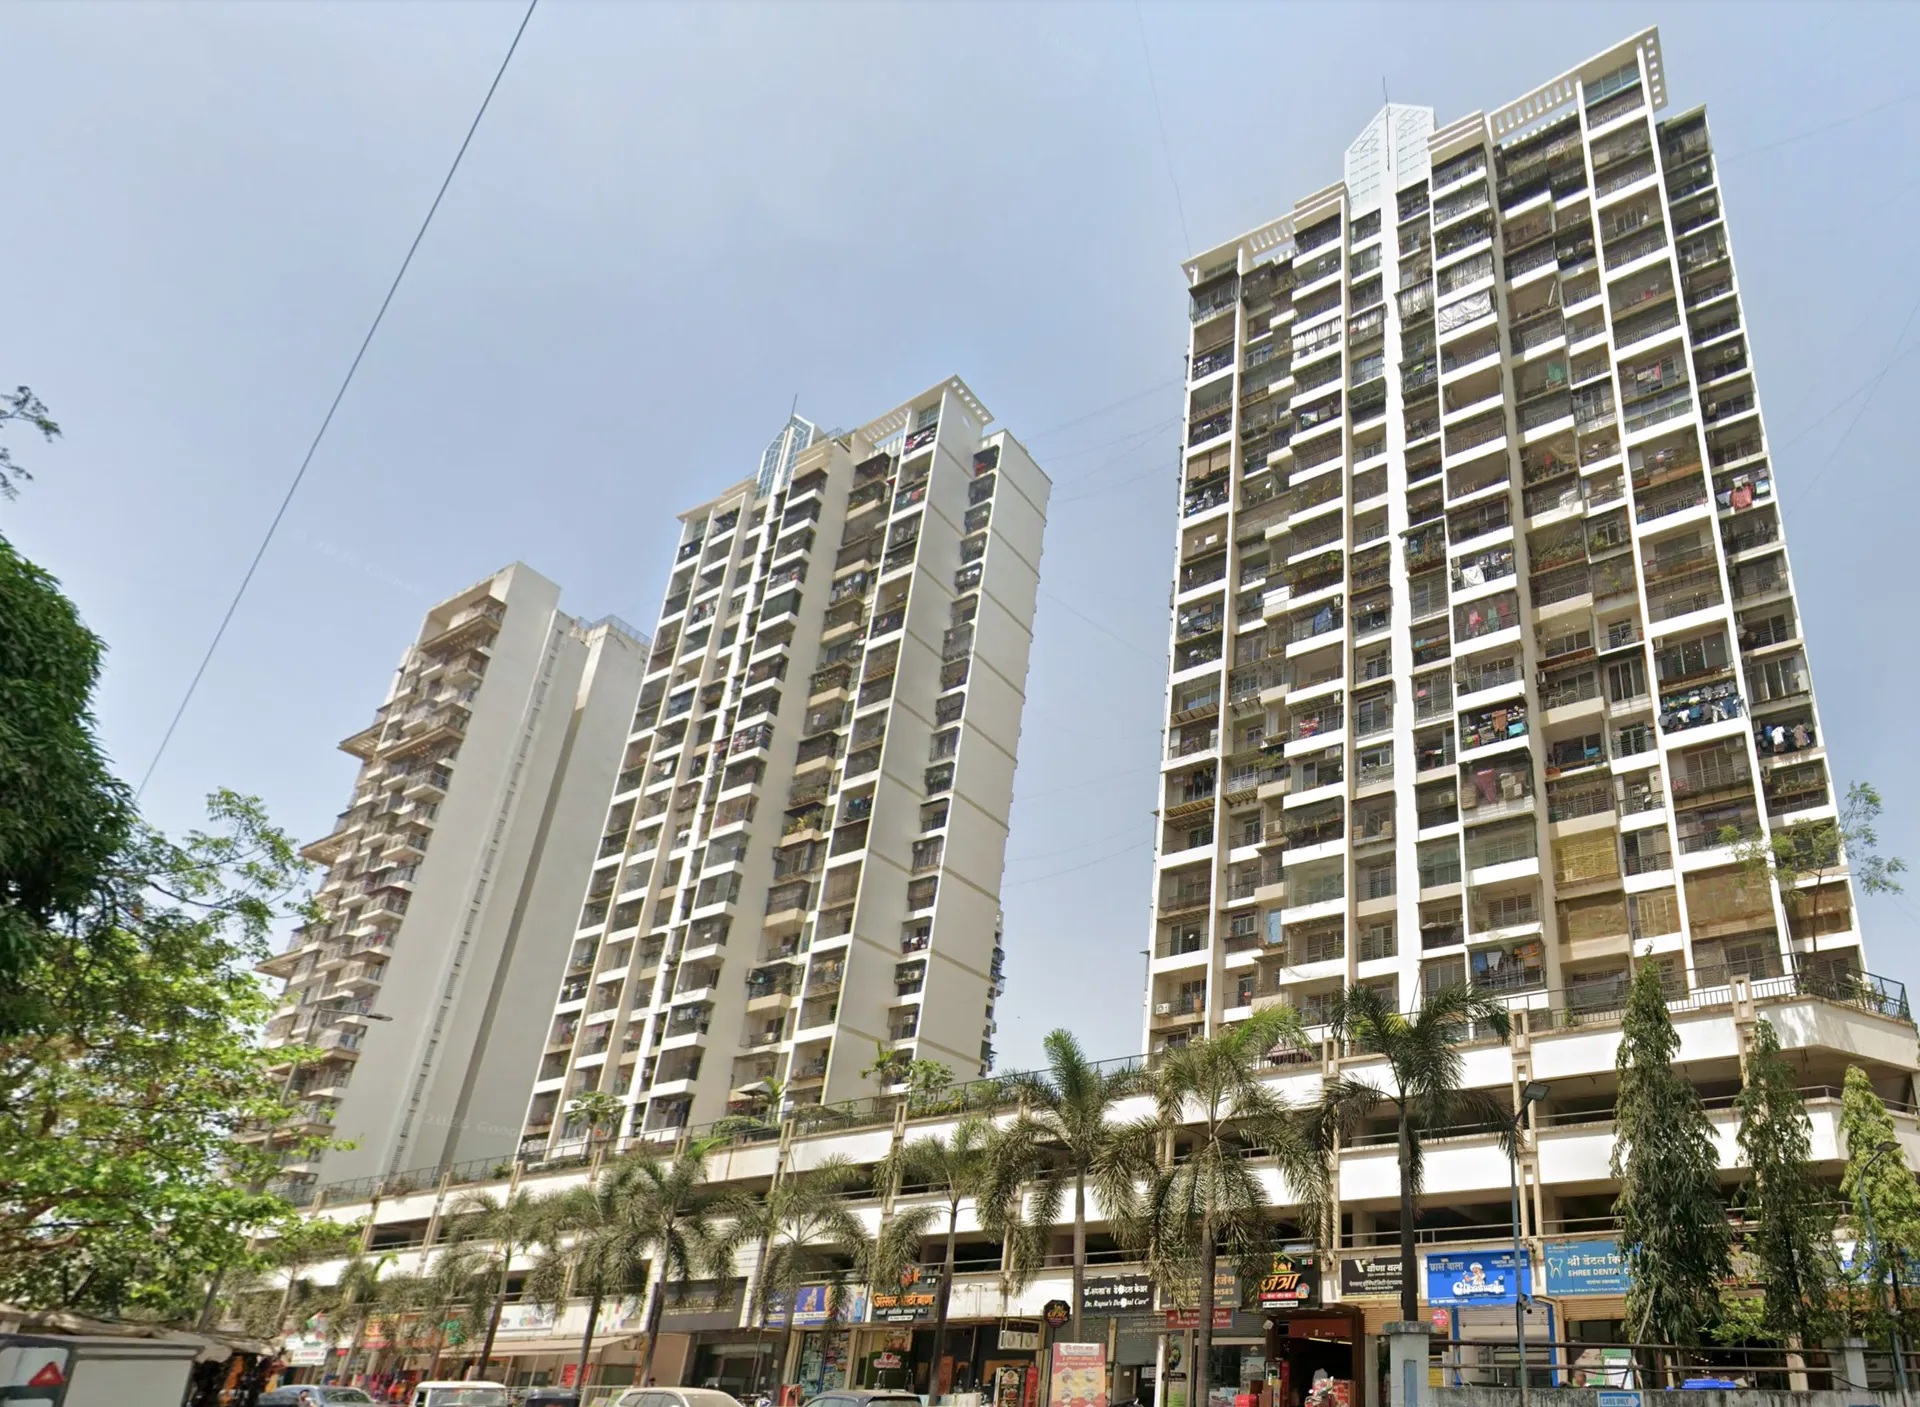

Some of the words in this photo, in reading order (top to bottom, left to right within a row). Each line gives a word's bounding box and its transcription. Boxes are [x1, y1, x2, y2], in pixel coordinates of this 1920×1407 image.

[1567, 1255, 1580, 1266] श्री
[1367, 1263, 1386, 1272] वीणा
[1568, 1269, 1591, 1277] SHREE
[1593, 1268, 1621, 1276] DENTAL
[1260, 1273, 1302, 1291] जत्रा
